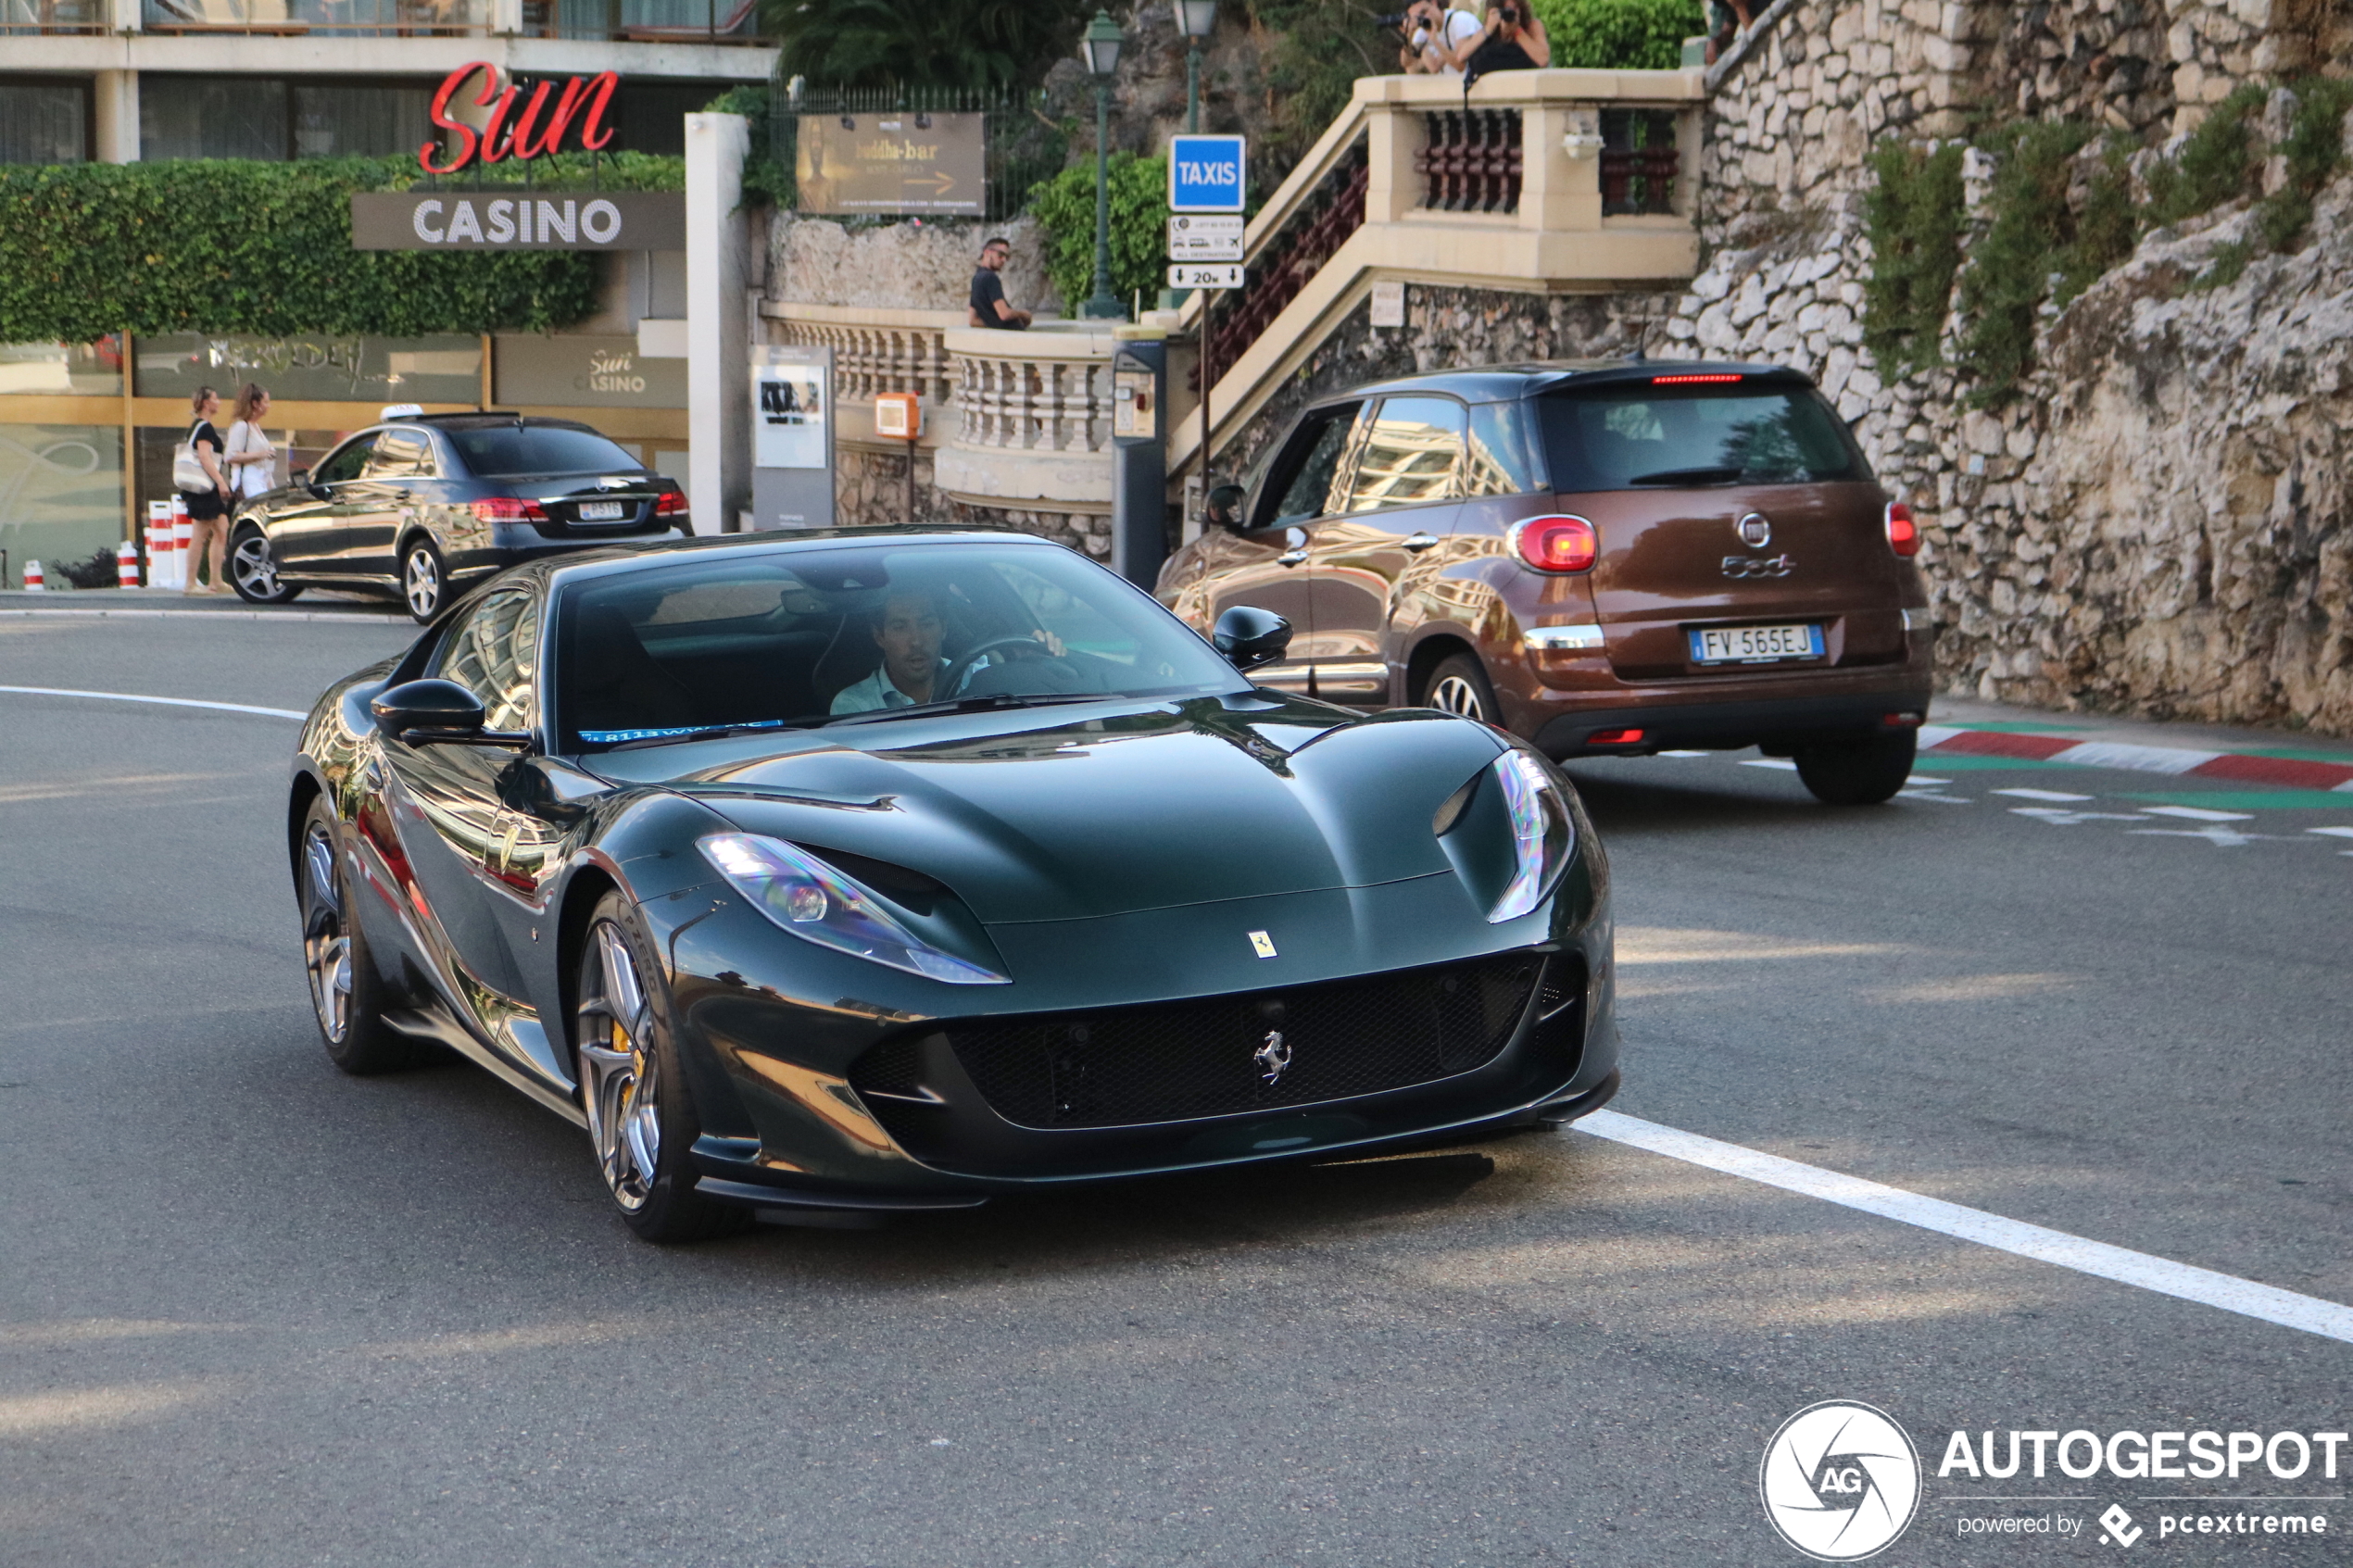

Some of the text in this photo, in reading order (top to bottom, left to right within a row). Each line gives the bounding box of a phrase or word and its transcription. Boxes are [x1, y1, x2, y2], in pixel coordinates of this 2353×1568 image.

[419, 61, 618, 174] Sun
[1178, 161, 1237, 185] TAXIS
[413, 199, 622, 244] CASINO
